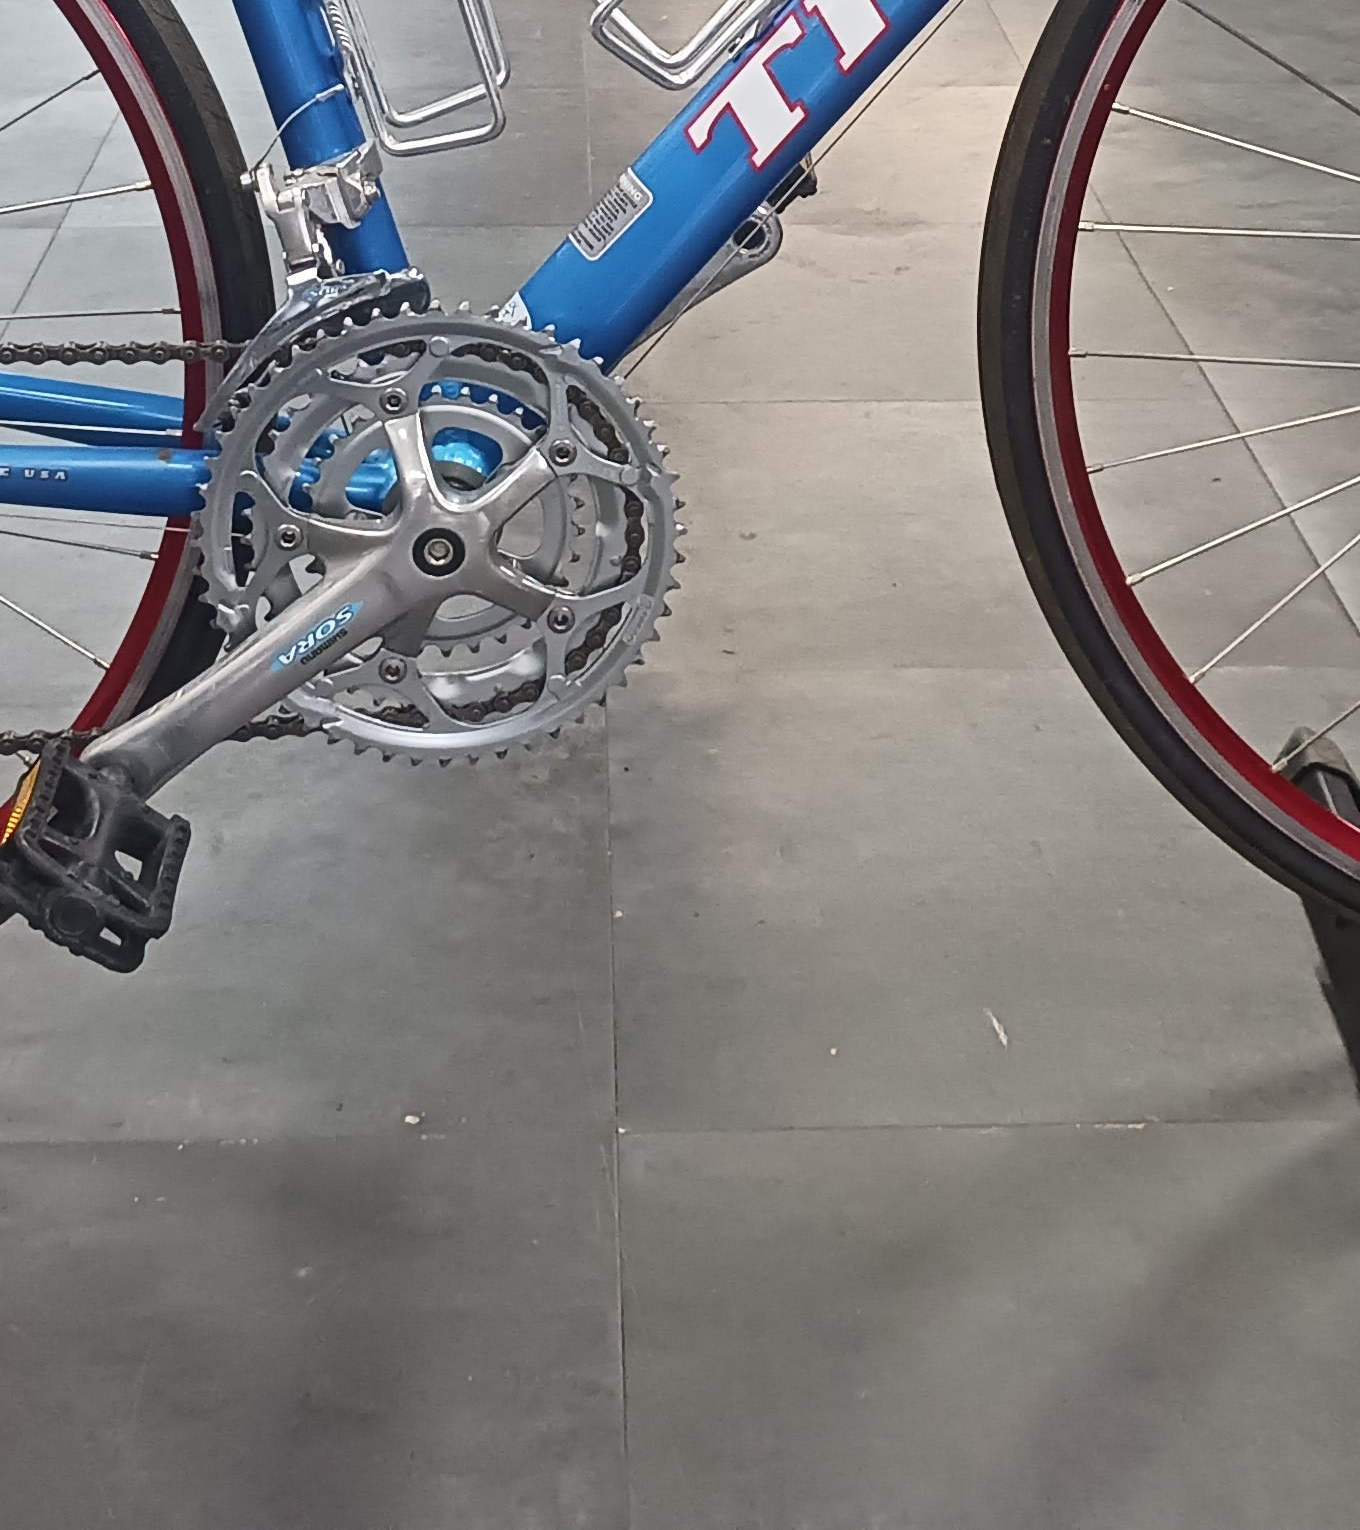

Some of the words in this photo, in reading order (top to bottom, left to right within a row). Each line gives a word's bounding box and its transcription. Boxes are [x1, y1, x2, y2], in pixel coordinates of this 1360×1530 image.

[24, 468, 67, 481] USA
[277, 604, 353, 665] SORA
[300, 627, 349, 666] SHIMANO
